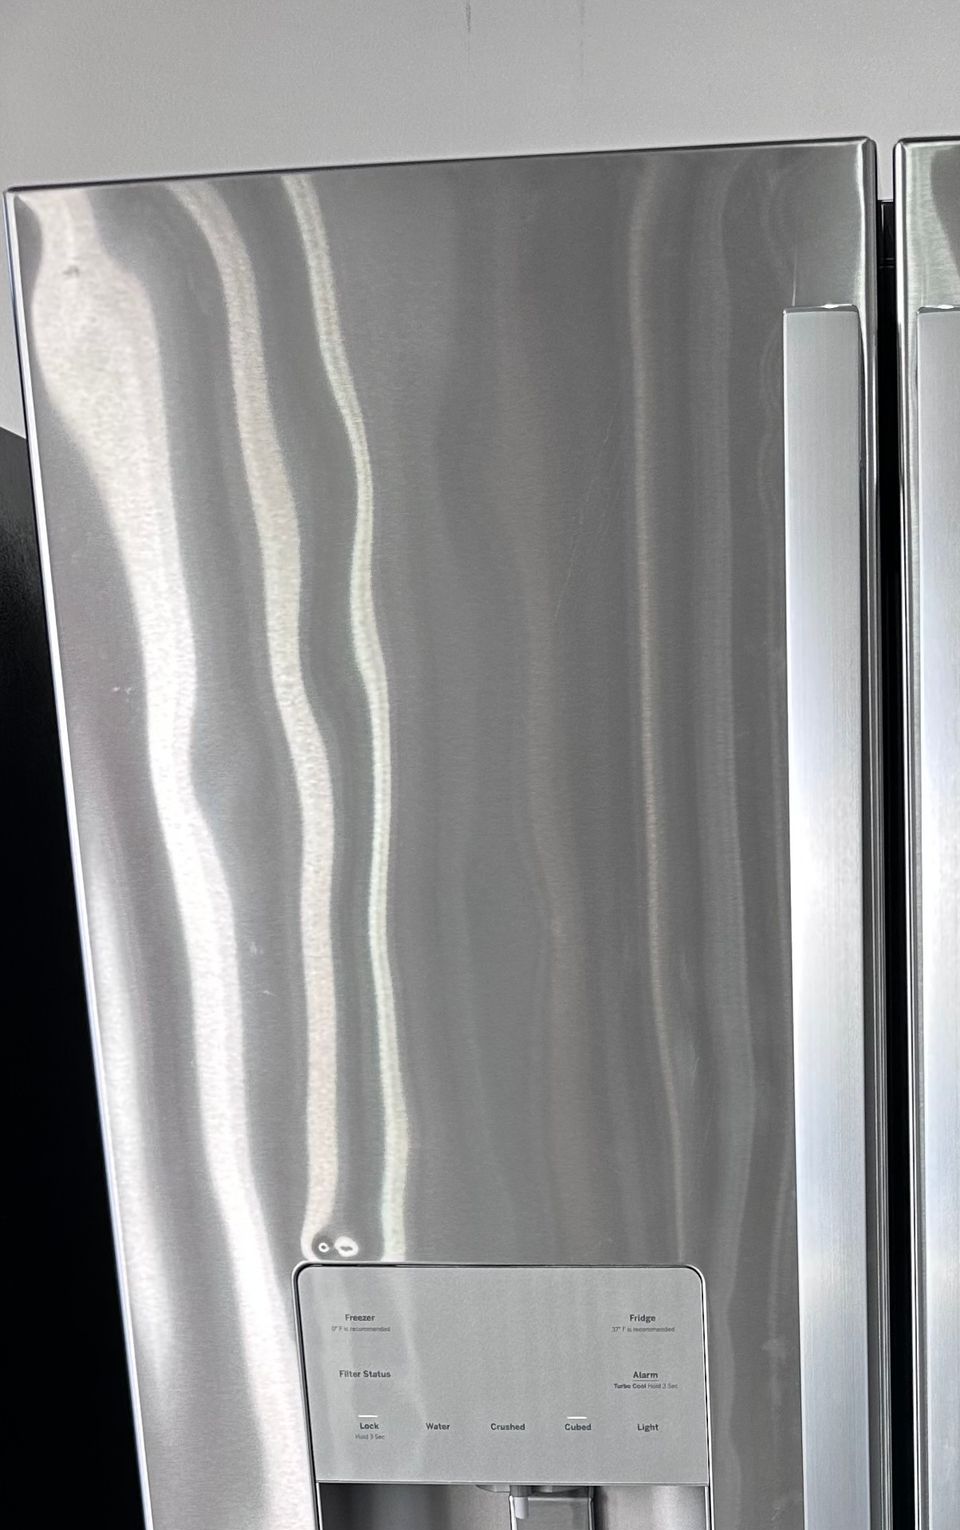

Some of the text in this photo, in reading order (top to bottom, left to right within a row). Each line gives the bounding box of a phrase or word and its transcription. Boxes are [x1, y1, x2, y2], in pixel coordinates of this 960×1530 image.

[344, 1313, 375, 1322] Freezer
[629, 1314, 656, 1323] Fridge
[339, 1369, 391, 1378] Filter Status
[632, 1371, 658, 1379] Alarm
[359, 1421, 379, 1430] Lock
[425, 1422, 450, 1431] Water
[490, 1422, 525, 1431] Crushed
[564, 1423, 592, 1431] Cubed
[637, 1423, 659, 1433] Light
